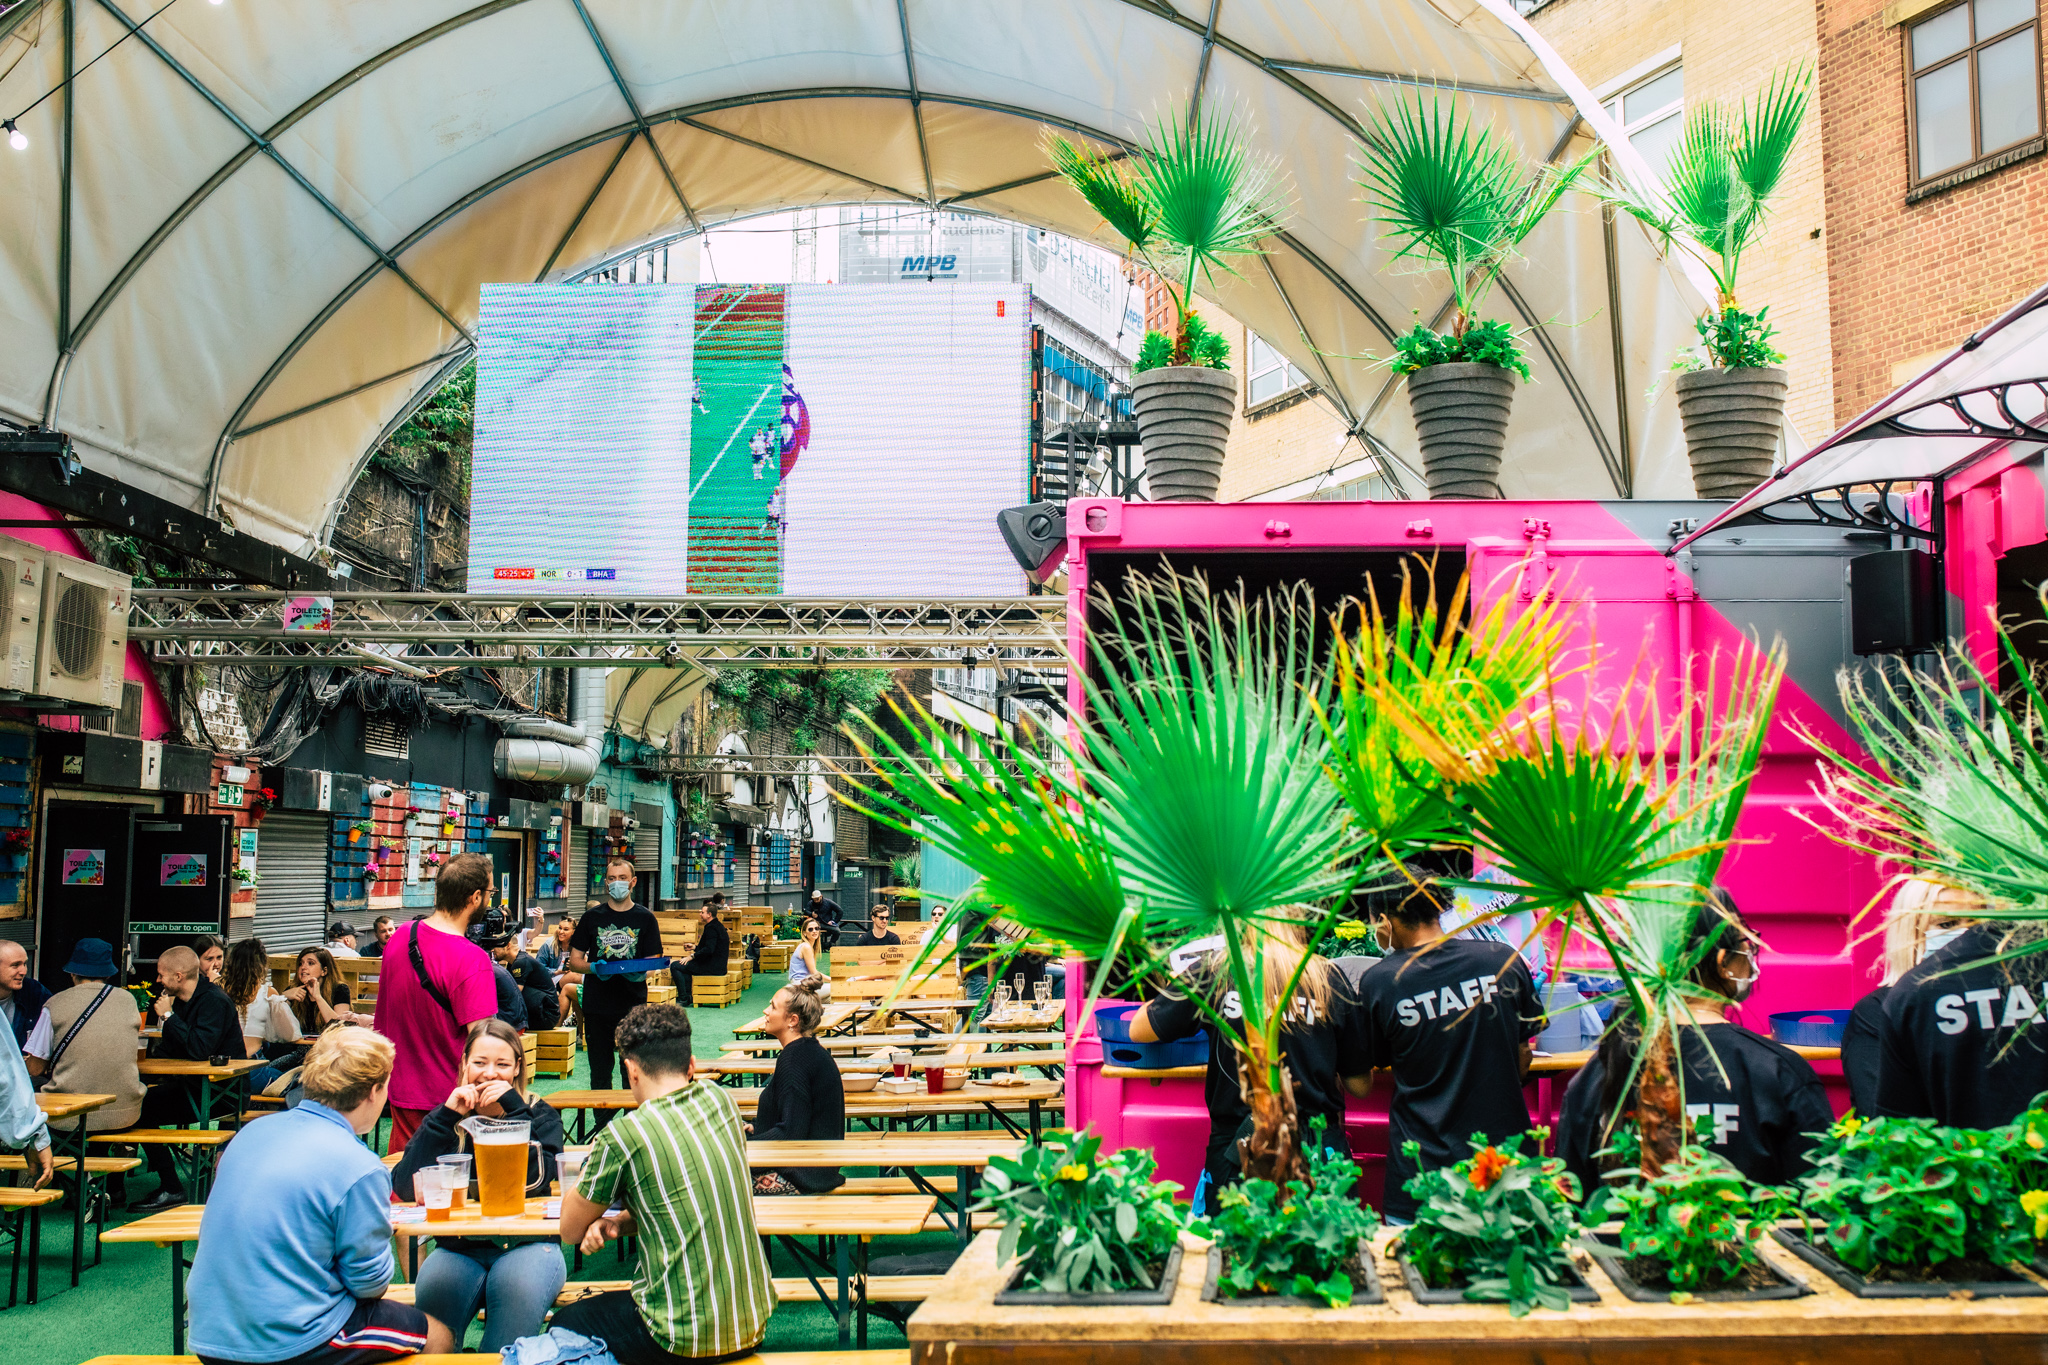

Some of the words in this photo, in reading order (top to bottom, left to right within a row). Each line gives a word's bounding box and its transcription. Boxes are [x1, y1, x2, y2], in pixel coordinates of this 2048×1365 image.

[940, 222, 1005, 236] tudents
[901, 254, 957, 271] MPB
[148, 757, 155, 775] F
[322, 784, 328, 799] E
[148, 923, 167, 931] Push
[169, 923, 182, 931] bar
[192, 925, 212, 933] open
[880, 952, 904, 960] Corona
[1396, 974, 1498, 1027] STAFF
[1935, 981, 2048, 1035] STA
